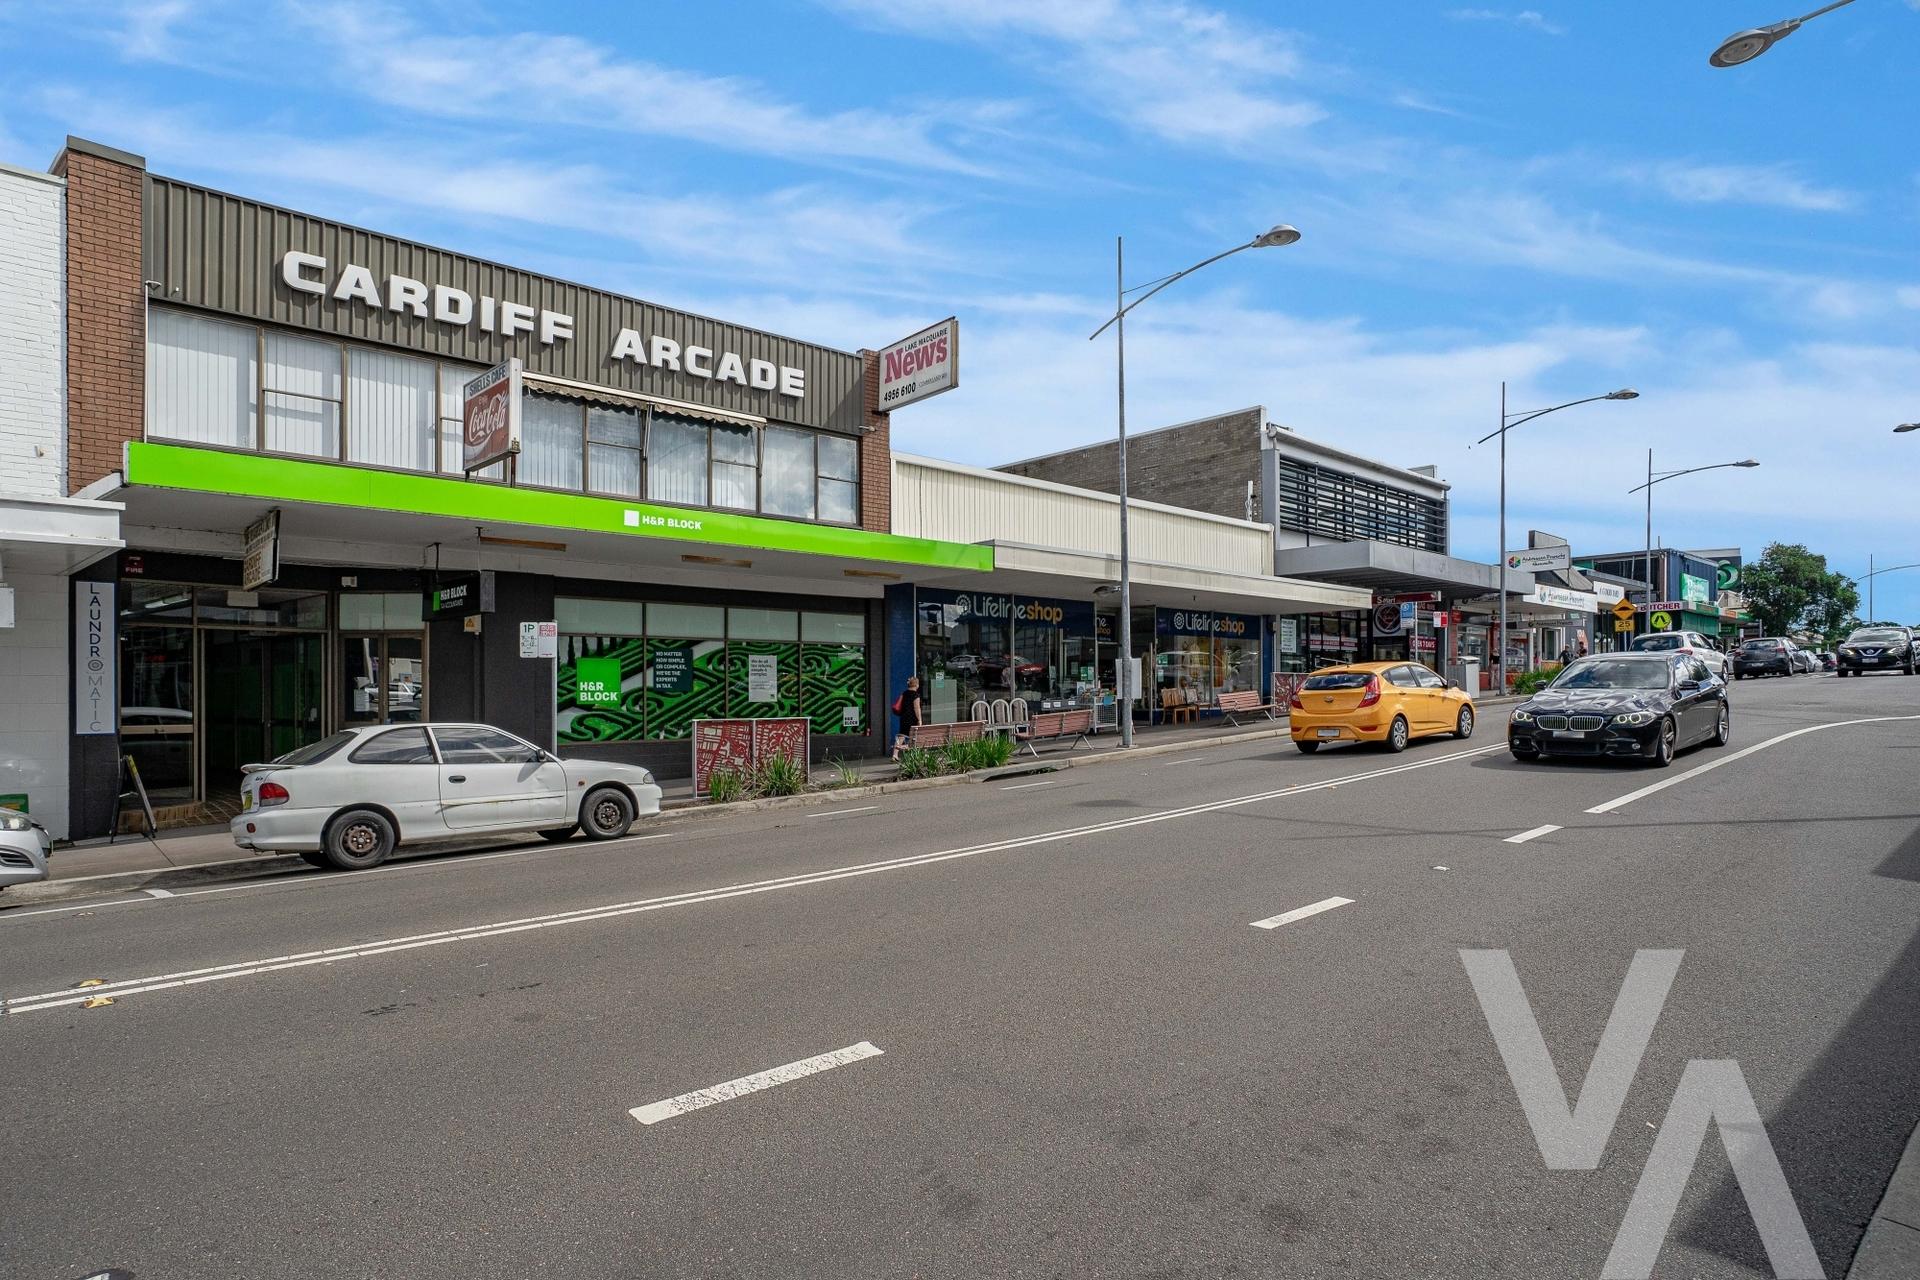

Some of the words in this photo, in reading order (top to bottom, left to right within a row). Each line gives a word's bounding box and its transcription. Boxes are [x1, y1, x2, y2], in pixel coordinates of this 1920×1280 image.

[282, 250, 574, 345] CARDIFF
[611, 327, 805, 398] ARCADE
[905, 341, 917, 352] LAKE
[919, 327, 948, 346] MACQUARIE
[884, 336, 948, 384] News
[491, 365, 506, 384] CAFE
[884, 388, 899, 402] 4956
[901, 382, 916, 396] 6100
[642, 515, 665, 526] H&R
[667, 518, 702, 530] BLOCK
[125, 566, 143, 574] FIRE
[440, 588, 450, 601] H&R
[450, 584, 468, 599] BLOCK
[524, 624, 535, 633] 1P
[580, 682, 604, 691] H&R
[580, 692, 618, 701] BLOCK
